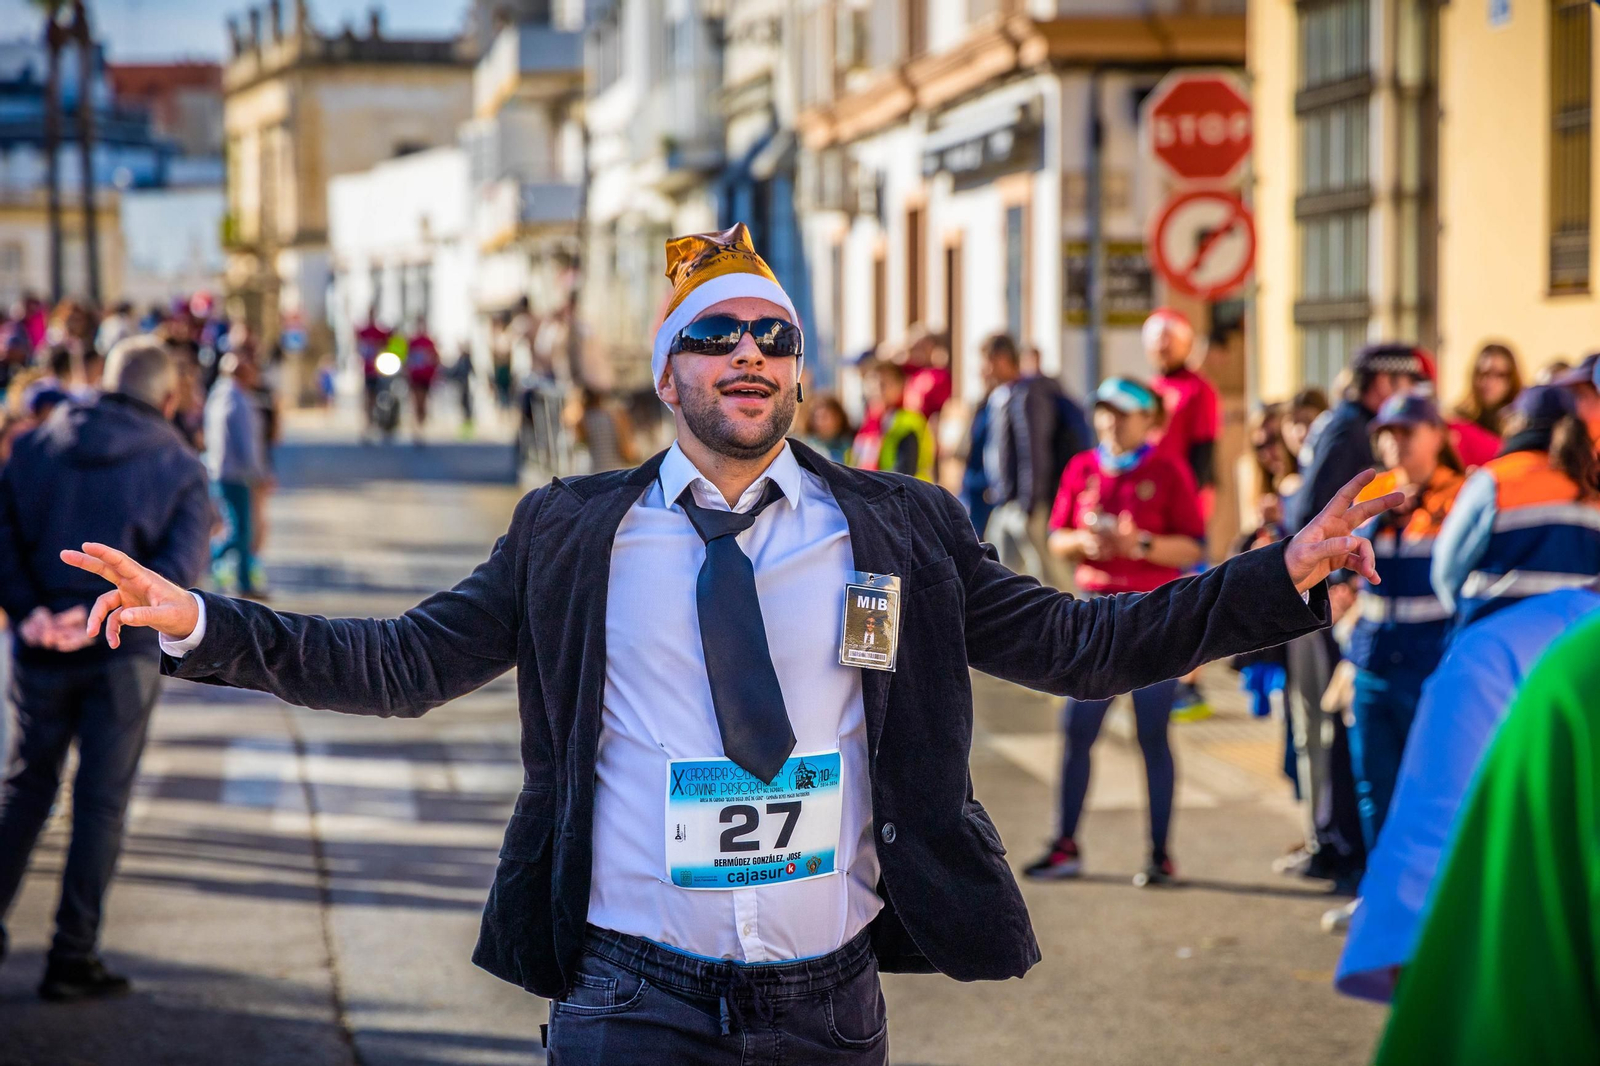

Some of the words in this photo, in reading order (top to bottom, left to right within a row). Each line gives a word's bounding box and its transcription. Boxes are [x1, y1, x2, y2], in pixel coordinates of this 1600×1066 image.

[1153, 112, 1250, 147] STOP
[857, 595, 888, 611] MIB
[685, 767, 728, 781] CARRERA
[819, 768, 830, 782] 10
[671, 769, 685, 796] X
[684, 782, 716, 796] DIVINA
[720, 781, 763, 796] PASTORA
[719, 800, 802, 853] 27
[714, 857, 750, 867] BERMÚDEZ
[752, 853, 785, 865] GONZÁLEZ,
[786, 851, 802, 861] JOSE
[727, 868, 784, 885] cajasur
